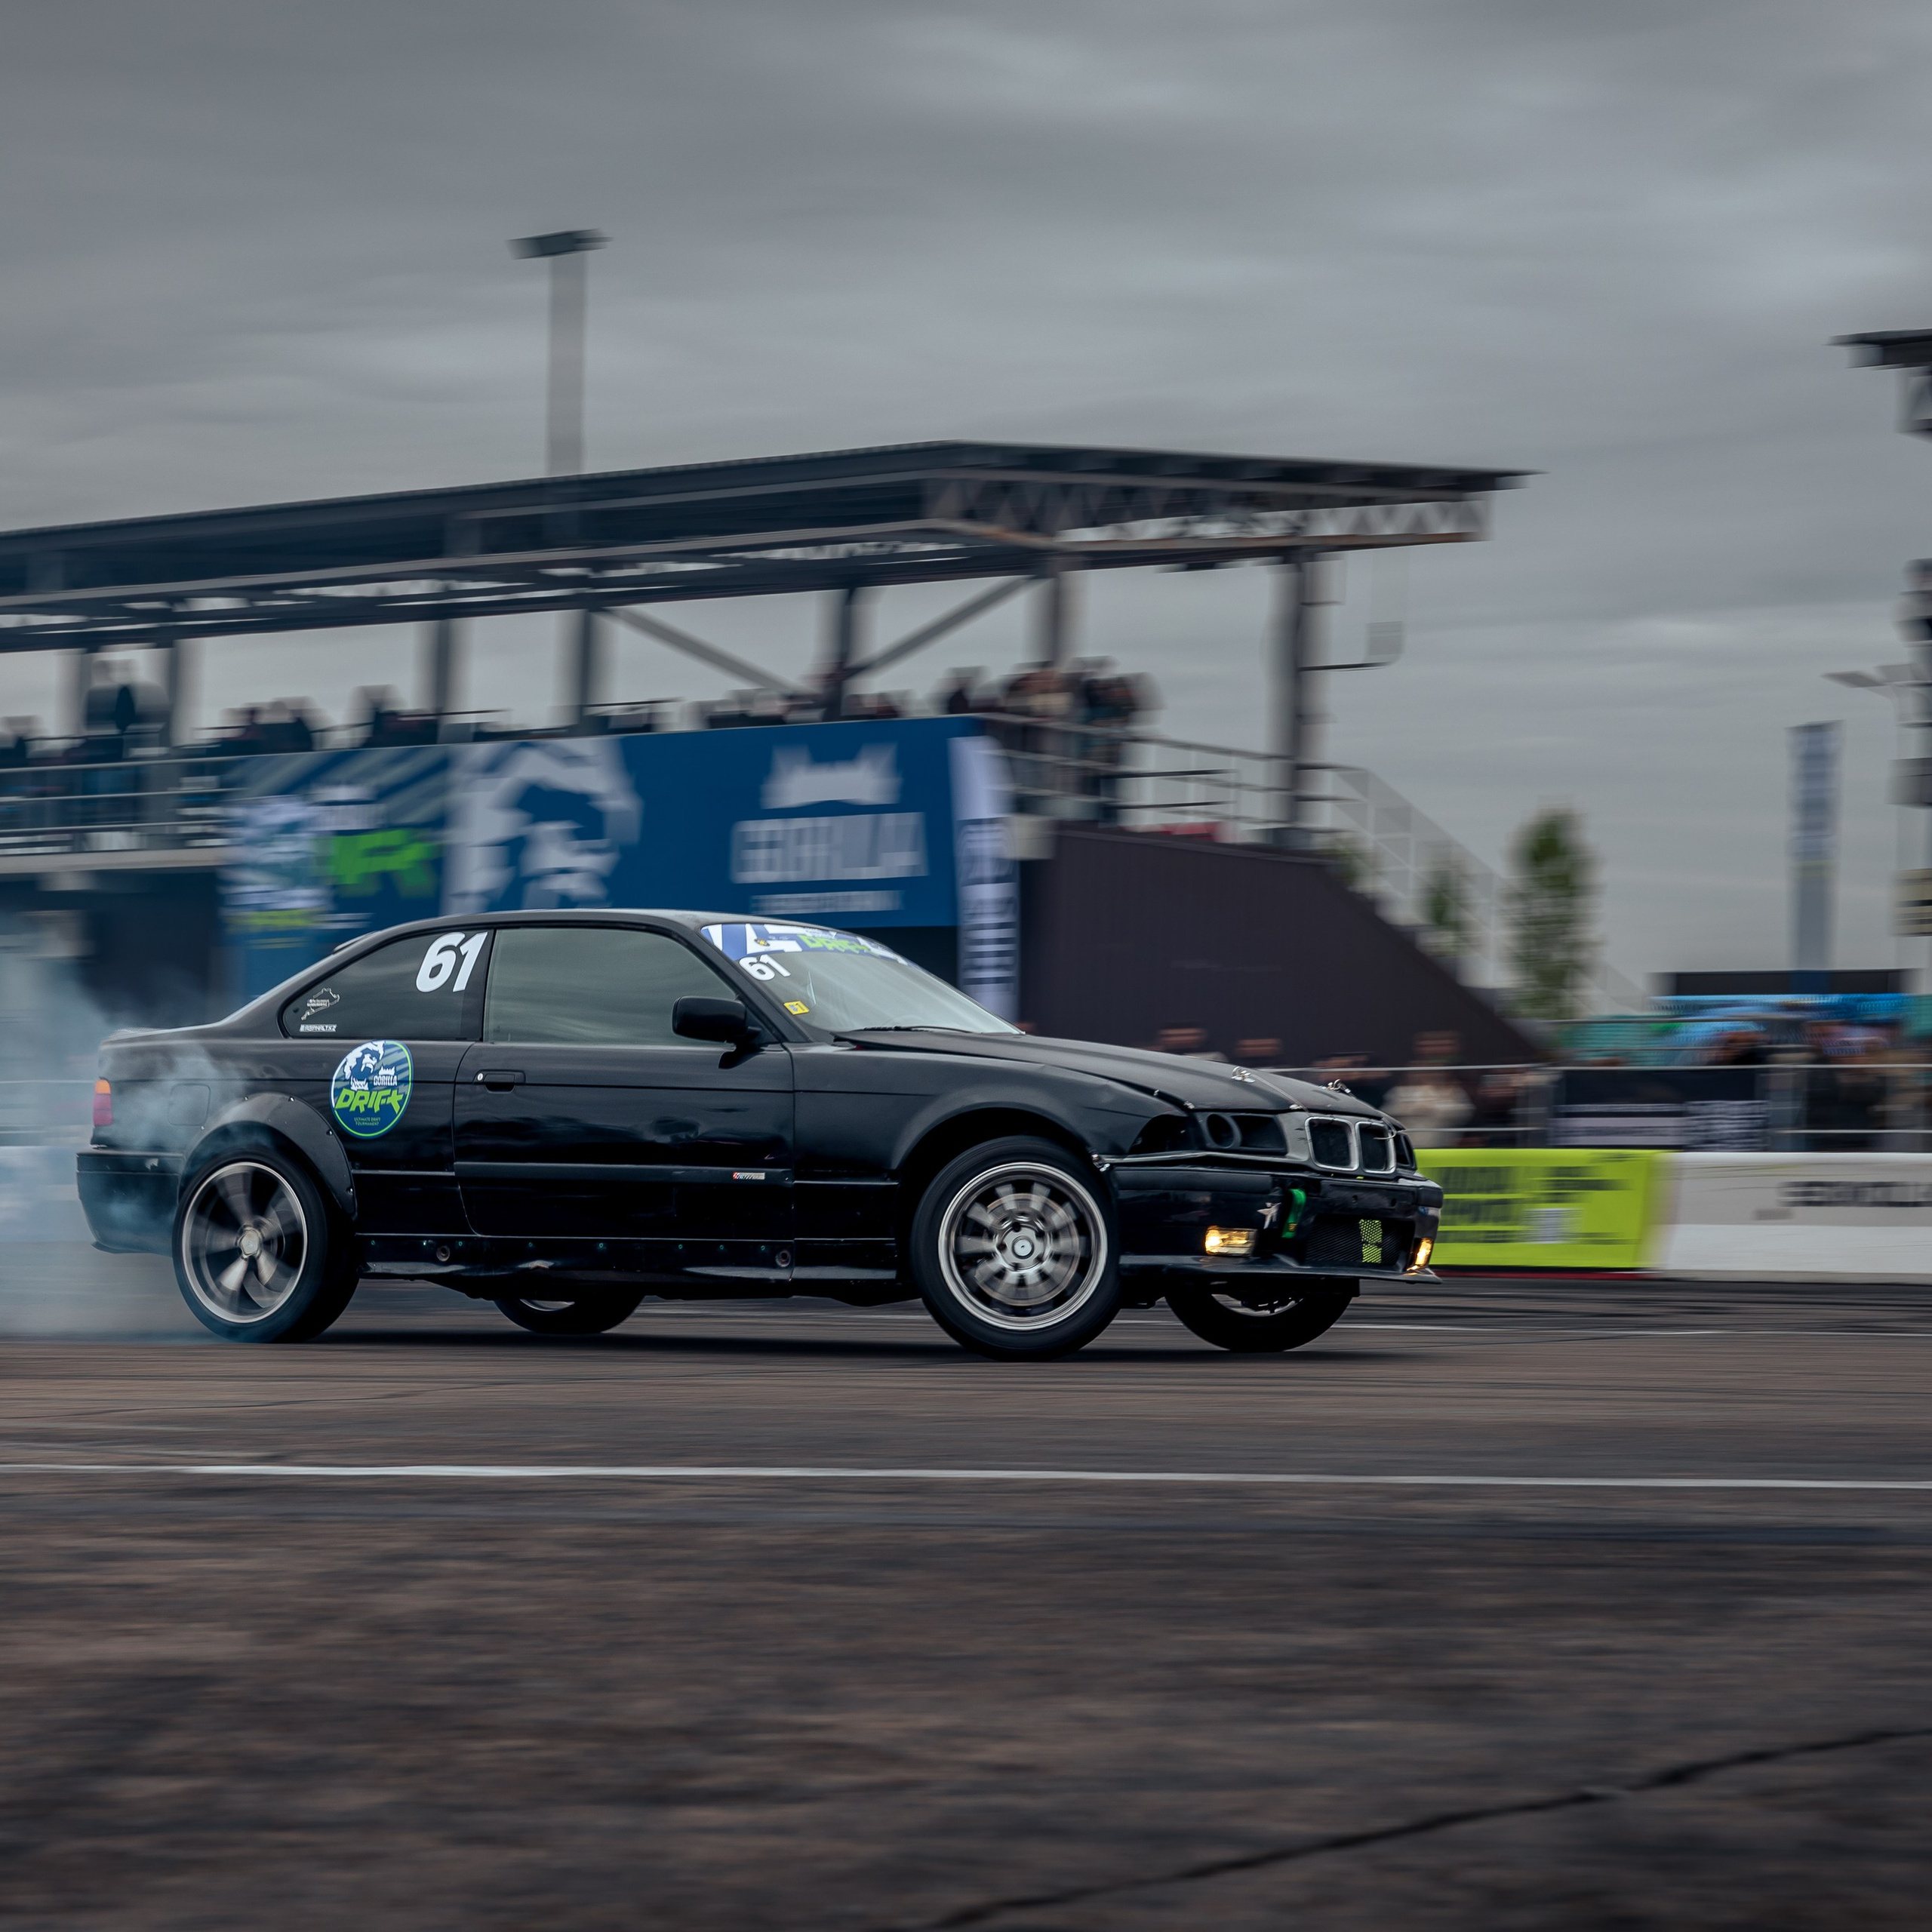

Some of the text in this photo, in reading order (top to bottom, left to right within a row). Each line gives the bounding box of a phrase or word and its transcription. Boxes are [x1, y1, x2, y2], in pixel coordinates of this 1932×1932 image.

[416, 932, 488, 992] 61
[739, 954, 792, 981] 61
[373, 1075, 398, 1086] GORILLA
[334, 1088, 404, 1115] DRIFT
